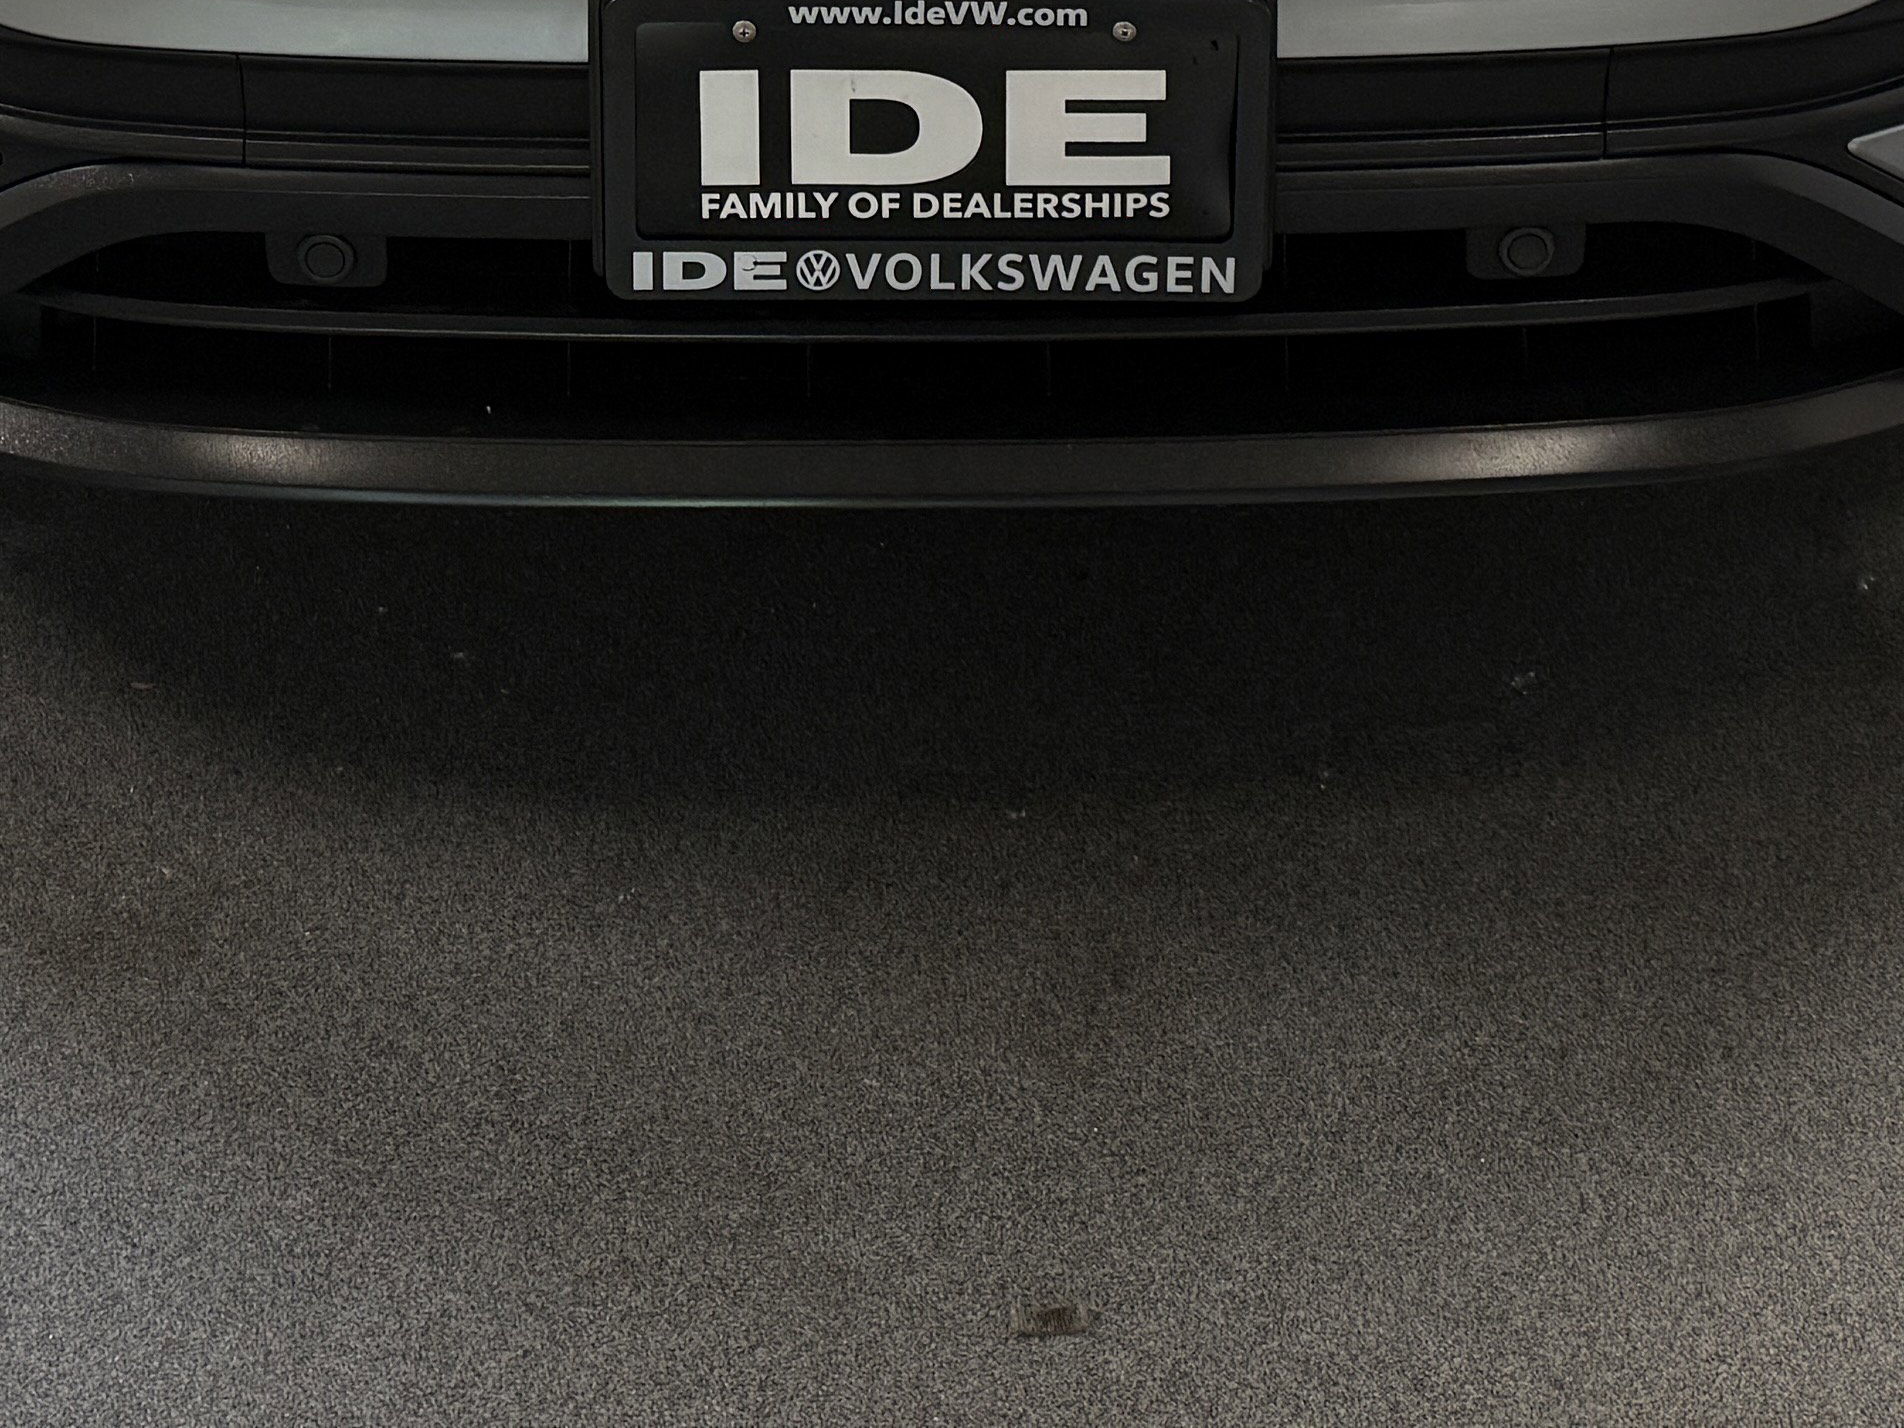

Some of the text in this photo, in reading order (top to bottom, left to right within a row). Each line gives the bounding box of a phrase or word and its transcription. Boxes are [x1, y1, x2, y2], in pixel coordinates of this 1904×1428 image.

[787, 0, 1088, 27] www.IdeVW.com
[699, 69, 1171, 187] IDE
[701, 191, 1170, 219] FAMILY OF DEALERSHIPS
[632, 250, 788, 291] IDE
[846, 253, 1236, 294] VOLKSWAGEN
